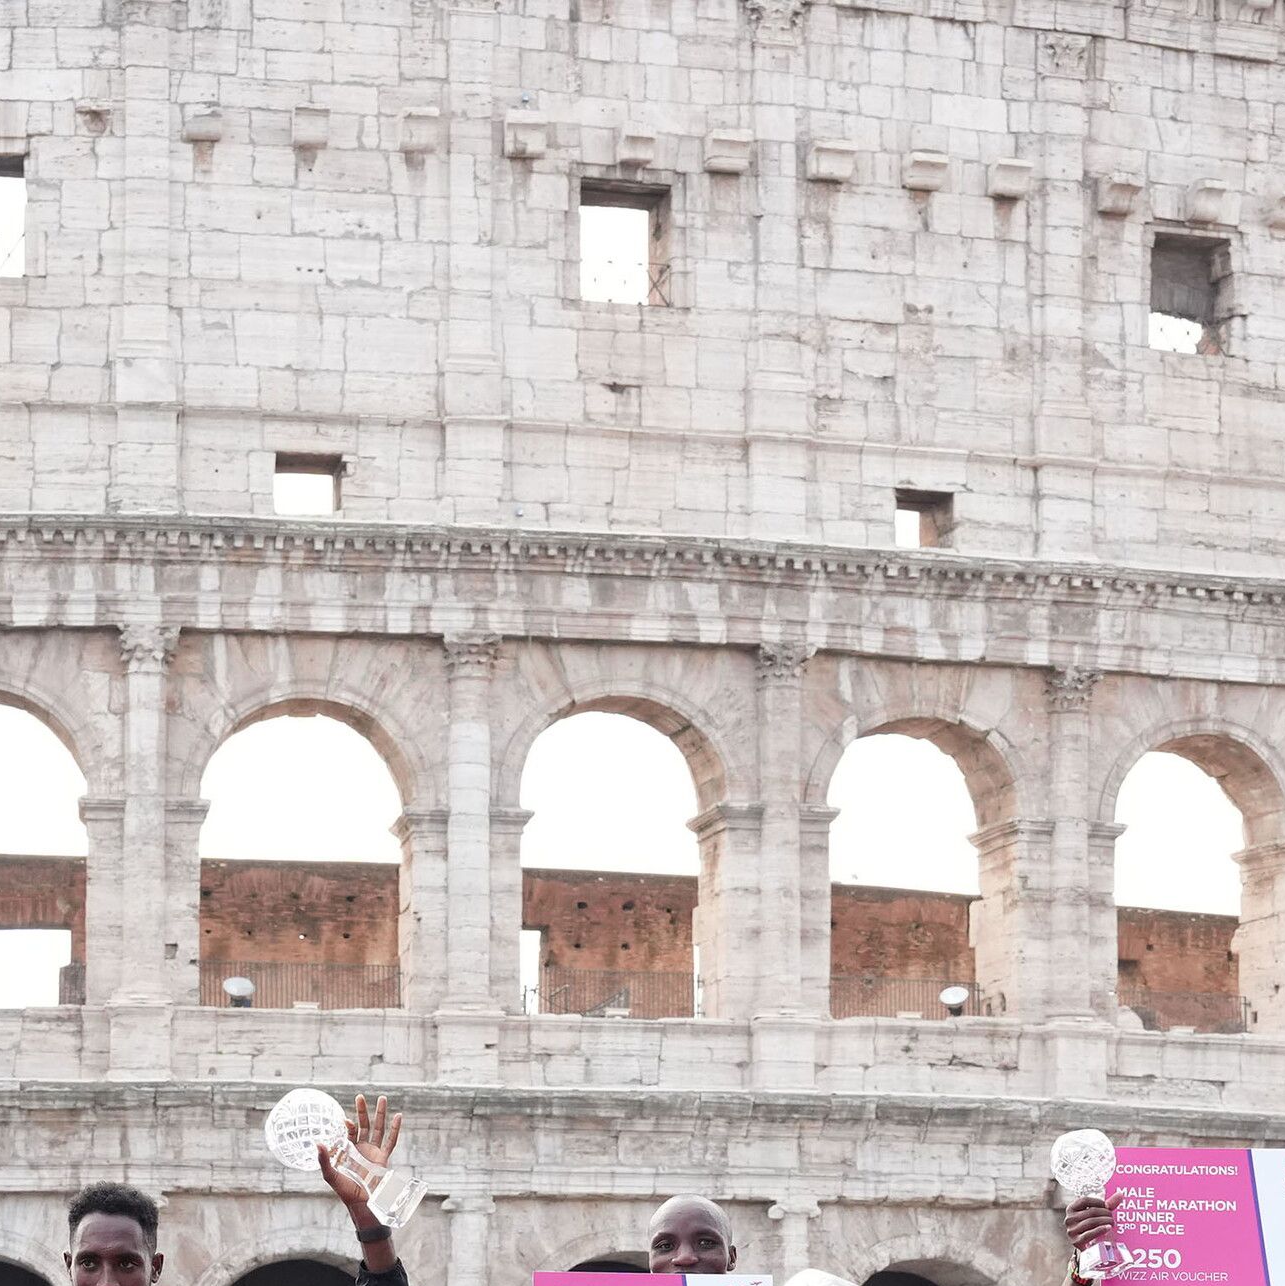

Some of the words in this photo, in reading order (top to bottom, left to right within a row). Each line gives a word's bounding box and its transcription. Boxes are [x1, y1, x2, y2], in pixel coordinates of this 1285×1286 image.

[1116, 1165, 1238, 1176] CONGRATULATIONS!
[1116, 1187, 1155, 1198] MALE
[1156, 1200, 1237, 1211] MARATHON
[1116, 1212, 1175, 1222] RUNNER
[1116, 1223, 1136, 1234] 3RD
[1140, 1224, 1185, 1235] PLACE
[1132, 1248, 1182, 1269] 250
[1149, 1272, 1169, 1280] AIR
[1171, 1272, 1229, 1281] VOUCHER
